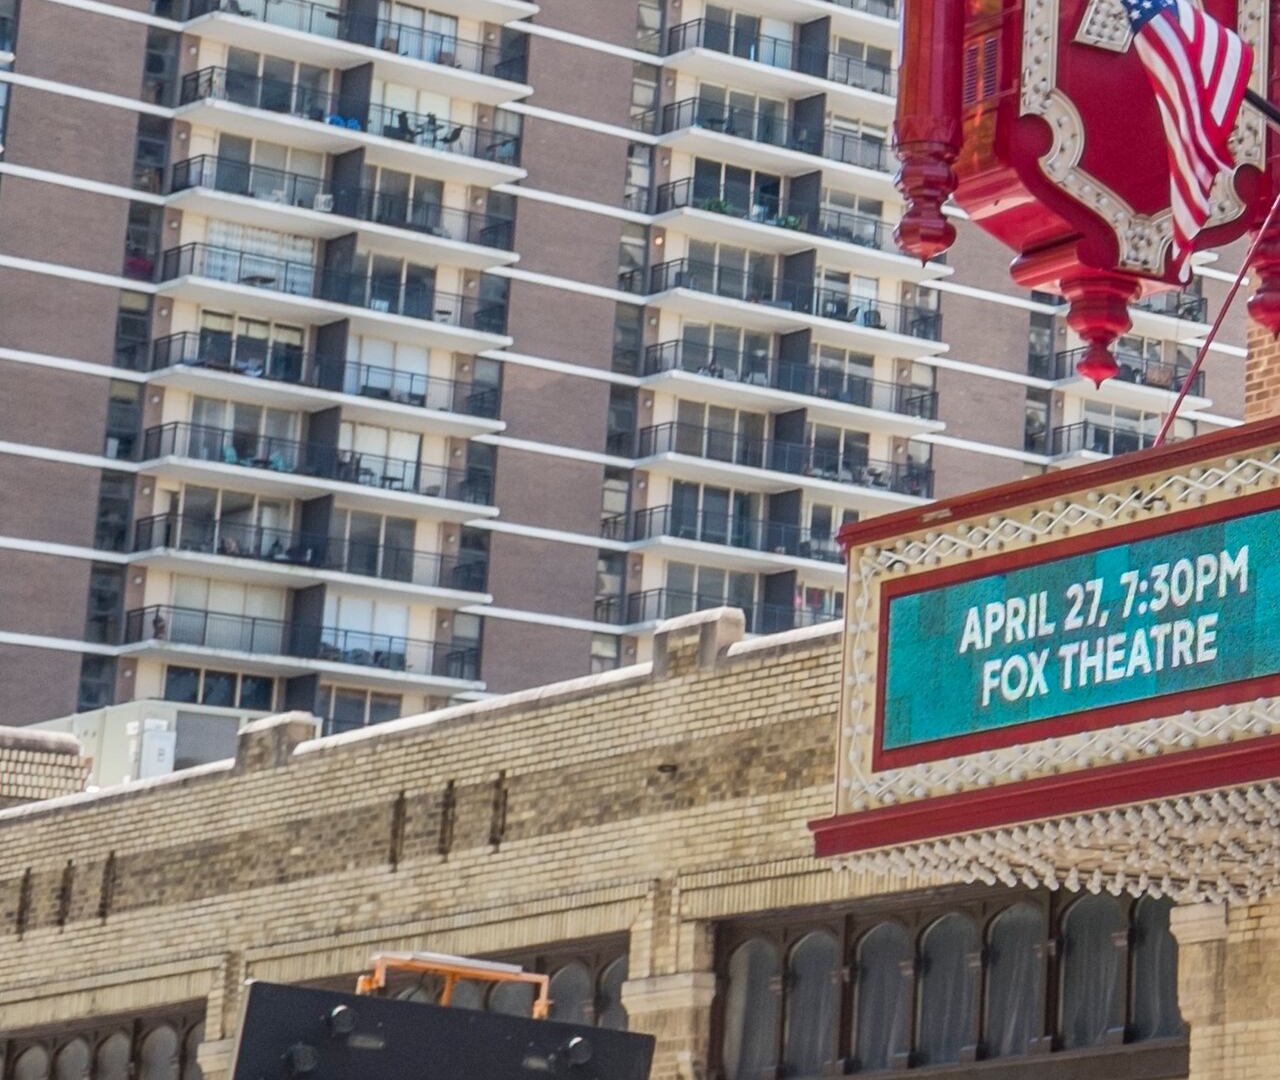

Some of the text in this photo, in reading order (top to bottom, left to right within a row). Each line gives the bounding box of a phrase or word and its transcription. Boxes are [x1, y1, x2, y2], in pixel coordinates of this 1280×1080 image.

[959, 545, 1249, 653] APRIL 27, 7:30PM
[982, 613, 1219, 706] FOX THEATRE
